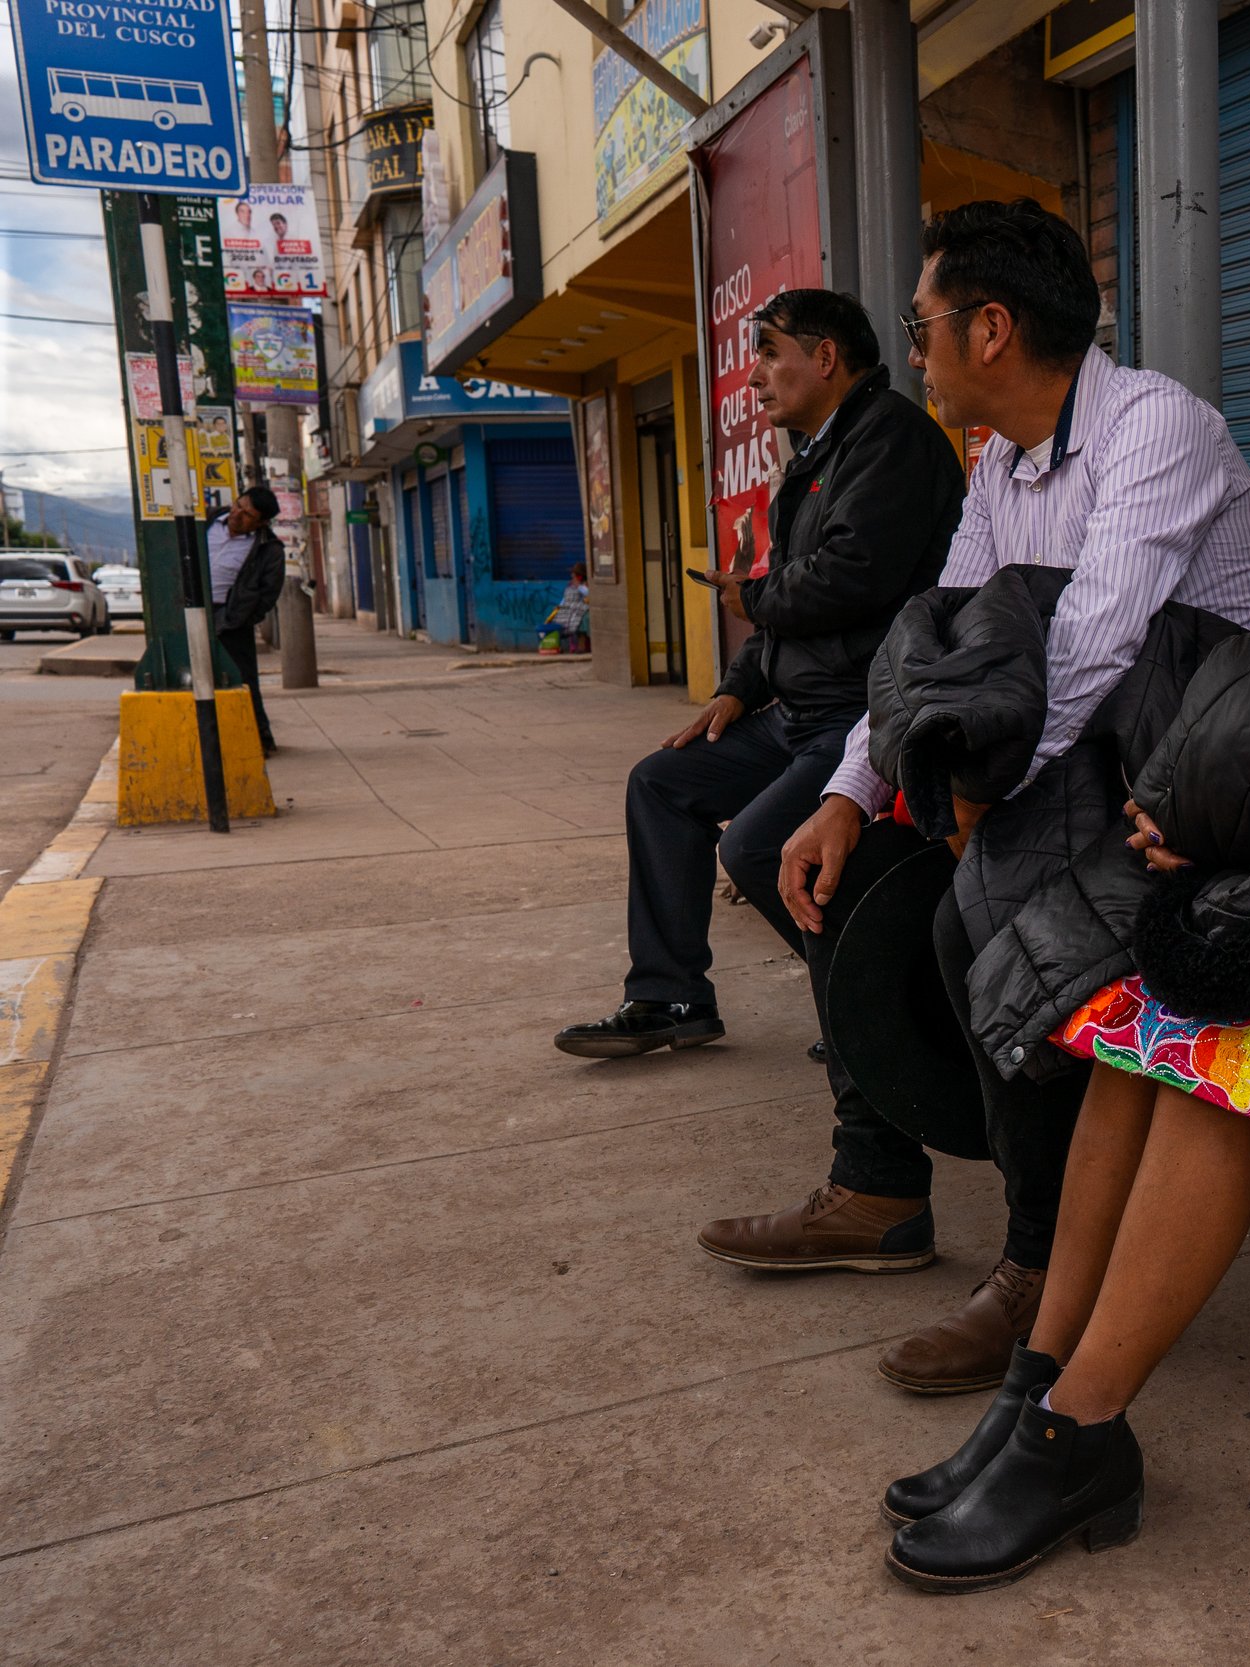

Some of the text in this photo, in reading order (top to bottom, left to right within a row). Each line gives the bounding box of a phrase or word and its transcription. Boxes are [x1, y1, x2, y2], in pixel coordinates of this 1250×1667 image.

[46, 0, 195, 29] PROVINCIAL
[56, 20, 196, 48] DEL CUSCO
[45, 133, 232, 181] PARADERO
[304, 273, 318, 289] 1
[713, 264, 751, 325] CUSCO
[718, 338, 734, 378] LA
[463, 377, 552, 399] CA
[720, 386, 747, 437] QUE
[723, 421, 773, 499] MÁS
